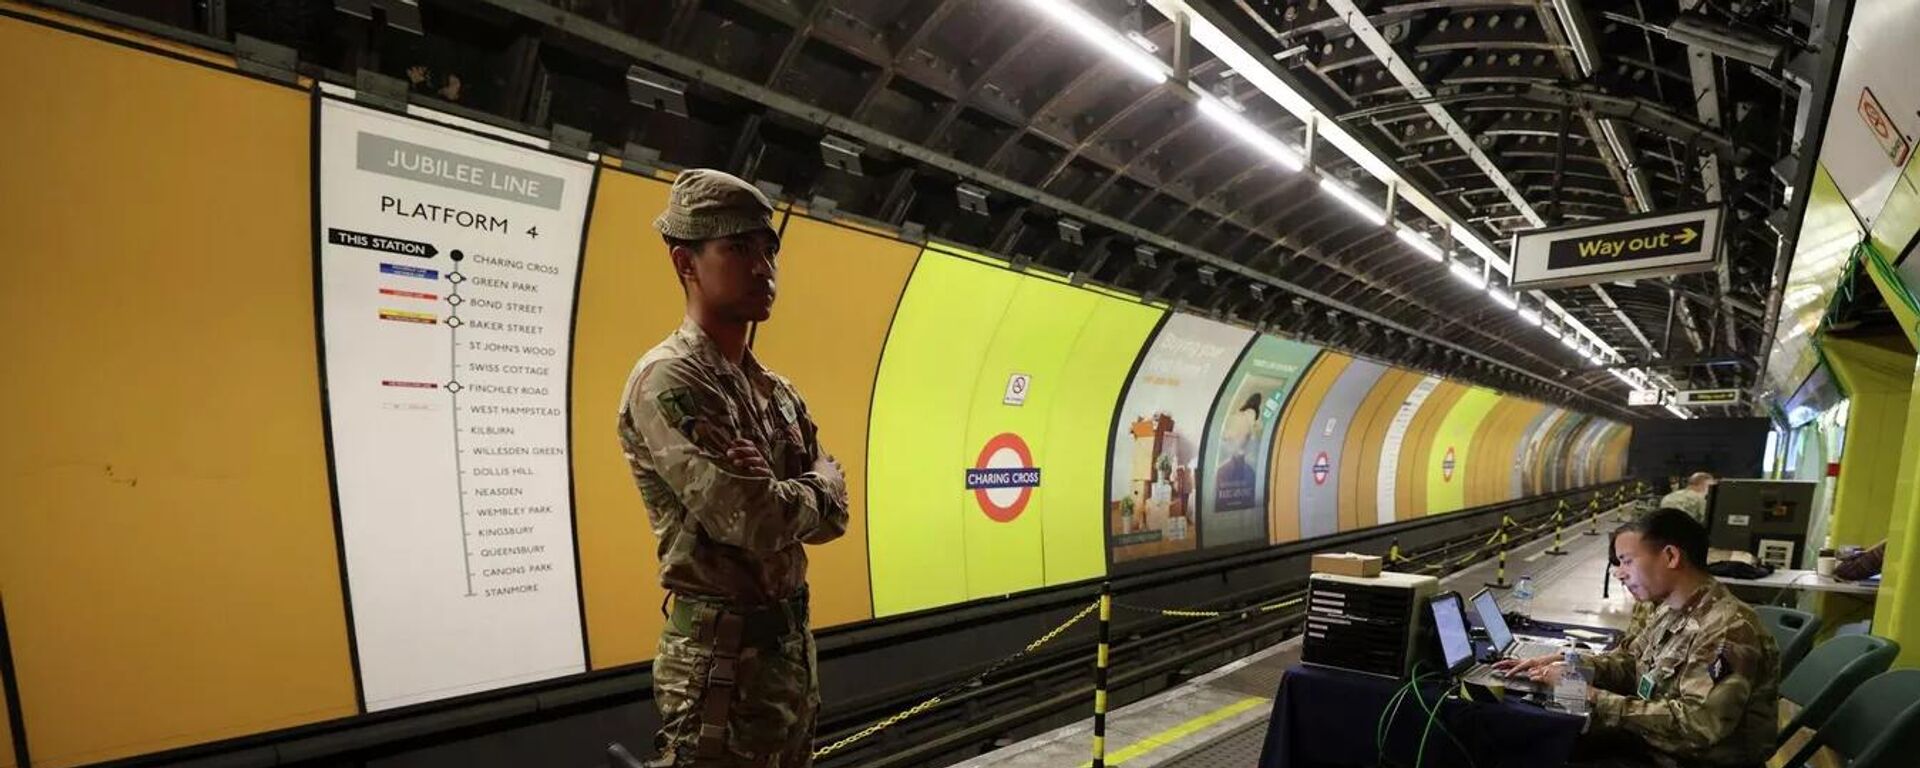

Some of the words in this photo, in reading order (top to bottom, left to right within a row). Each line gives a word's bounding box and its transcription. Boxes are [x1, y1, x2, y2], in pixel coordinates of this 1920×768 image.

[387, 149, 483, 186] JUBILEE
[491, 170, 541, 198] LINE
[381, 196, 508, 234] PLATFORM
[526, 226, 539, 239] 4
[338, 232, 368, 246] THIS
[372, 238, 426, 255] STATION
[1579, 239, 1625, 257] Way
[1628, 233, 1670, 251] out
[473, 254, 524, 270] CHARING
[526, 262, 559, 276] CROSS
[472, 276, 509, 290] GREEN
[512, 281, 538, 293] PARK
[470, 298, 502, 311] BOND
[507, 302, 543, 314] STREET
[470, 320, 504, 332] BAKER
[507, 323, 543, 334] STREET
[469, 342, 480, 350] ST
[484, 342, 520, 354] JOHN'S
[522, 346, 556, 356] WOOD
[469, 364, 499, 374] SWISS
[502, 365, 549, 376] COTTAGE
[469, 384, 519, 394] FINCHLEY
[522, 386, 548, 396] ROAD
[471, 406, 500, 414] WEST
[502, 407, 560, 416] HAMPSTEAD
[471, 427, 514, 435] KILBURN
[473, 447, 529, 455] WILLESDEN
[474, 467, 509, 476] DOLLIS
[968, 473, 1009, 485] CHARING
[1012, 472, 1038, 483] CROSS
[475, 488, 523, 497] NEASDEN
[478, 507, 525, 517] WEMBLEY
[529, 506, 552, 514] PARK
[478, 527, 533, 537] KINGSBURY
[481, 546, 545, 557] QUEENSBURY
[483, 567, 525, 577] CANONS
[529, 564, 552, 574] PARK
[485, 585, 538, 597] STANMORE
